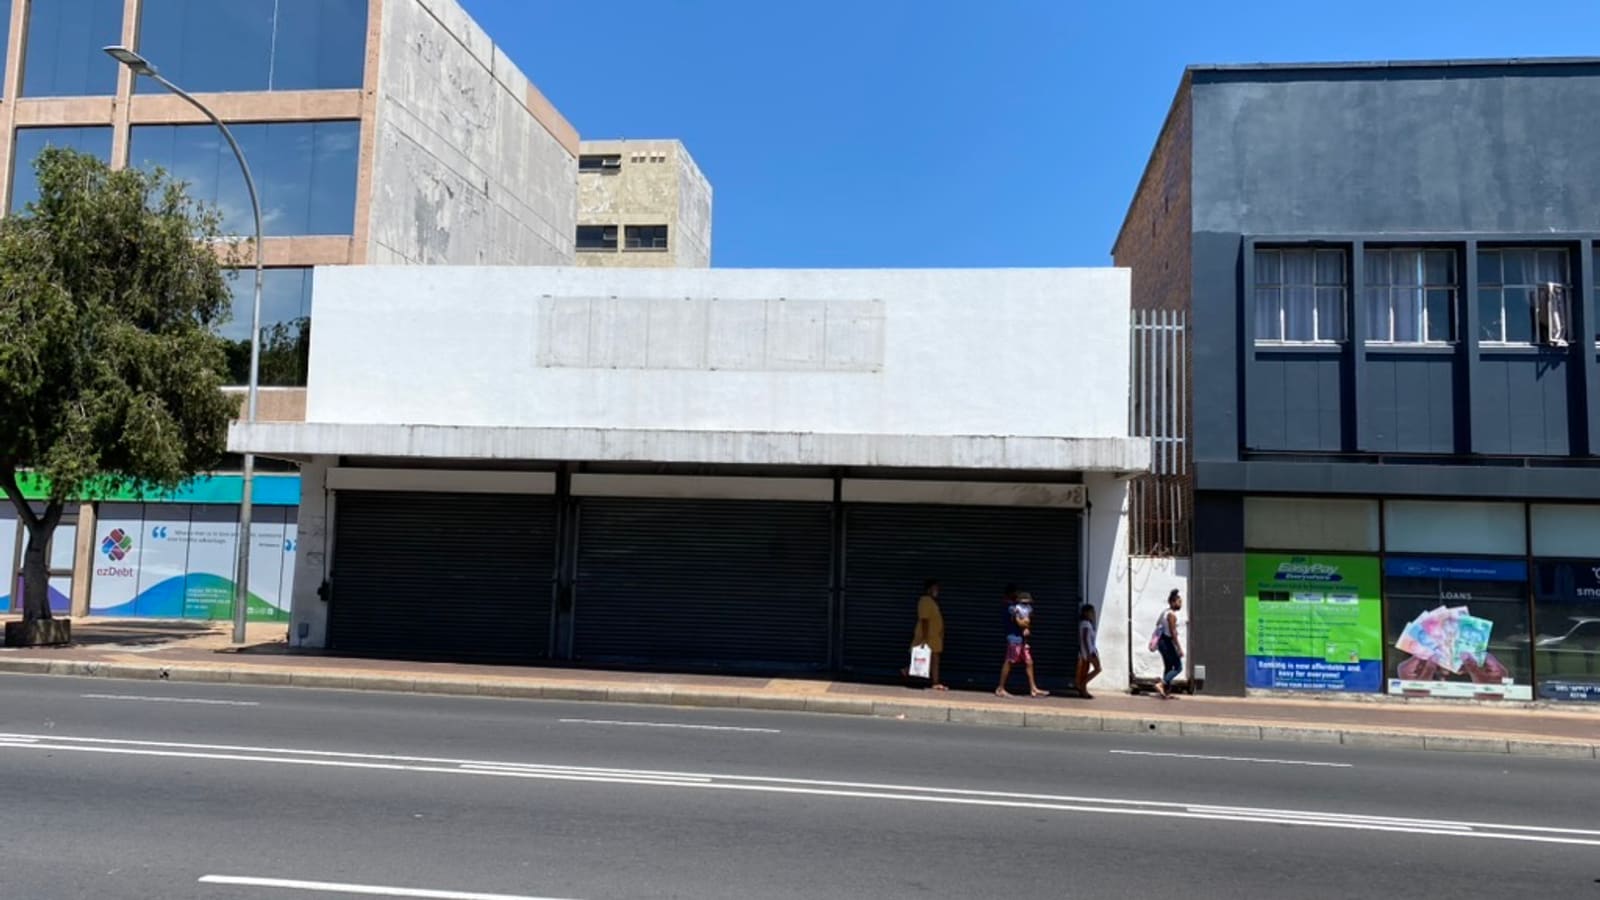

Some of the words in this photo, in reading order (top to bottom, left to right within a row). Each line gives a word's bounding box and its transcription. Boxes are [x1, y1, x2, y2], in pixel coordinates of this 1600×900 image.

[96, 566, 134, 578] ezDebt
[1277, 562, 1339, 575] EasyPay
[1440, 591, 1473, 601] LOANS
[1258, 661, 1286, 671] Banking
[1311, 662, 1346, 672] affordable
[1295, 670, 1306, 678] for
